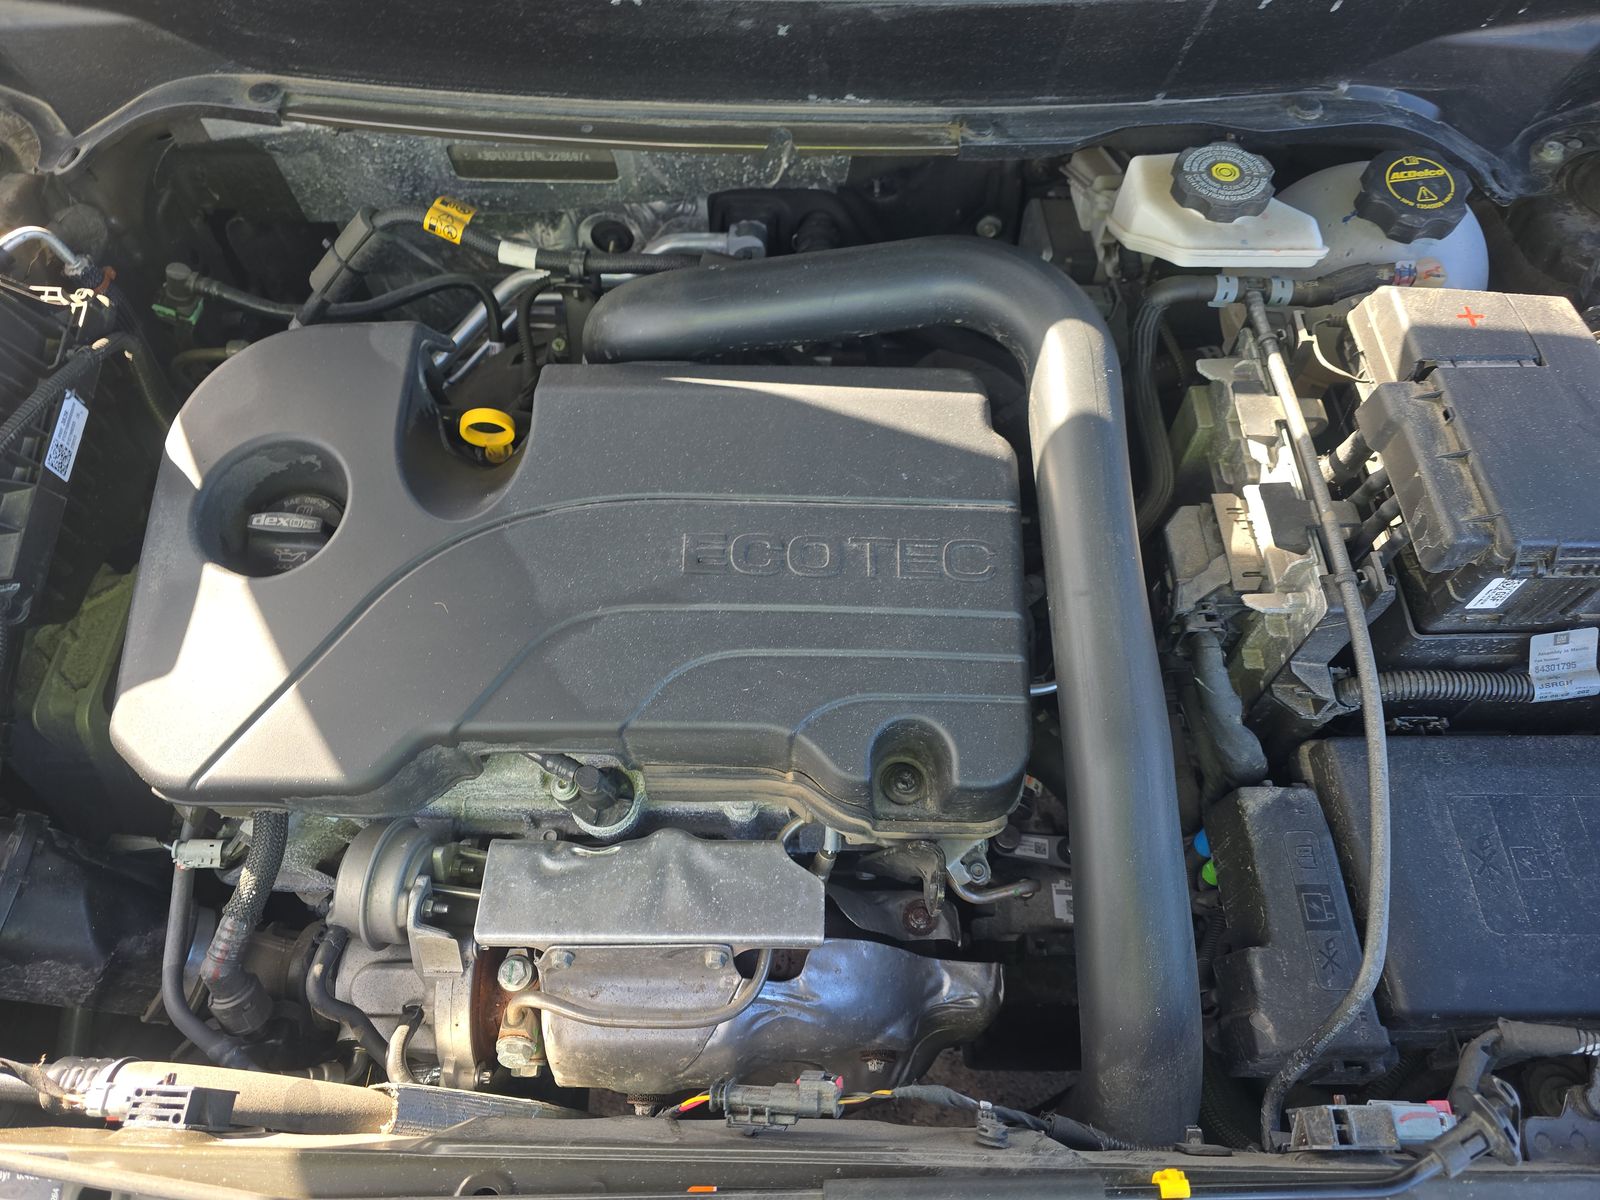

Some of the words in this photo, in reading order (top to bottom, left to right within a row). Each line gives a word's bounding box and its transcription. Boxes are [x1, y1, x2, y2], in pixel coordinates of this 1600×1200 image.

[1390, 169, 1445, 180] ACDelco
[252, 514, 317, 530] dexos
[682, 532, 996, 582] ECOTEC
[1534, 661, 1577, 674] 84301795
